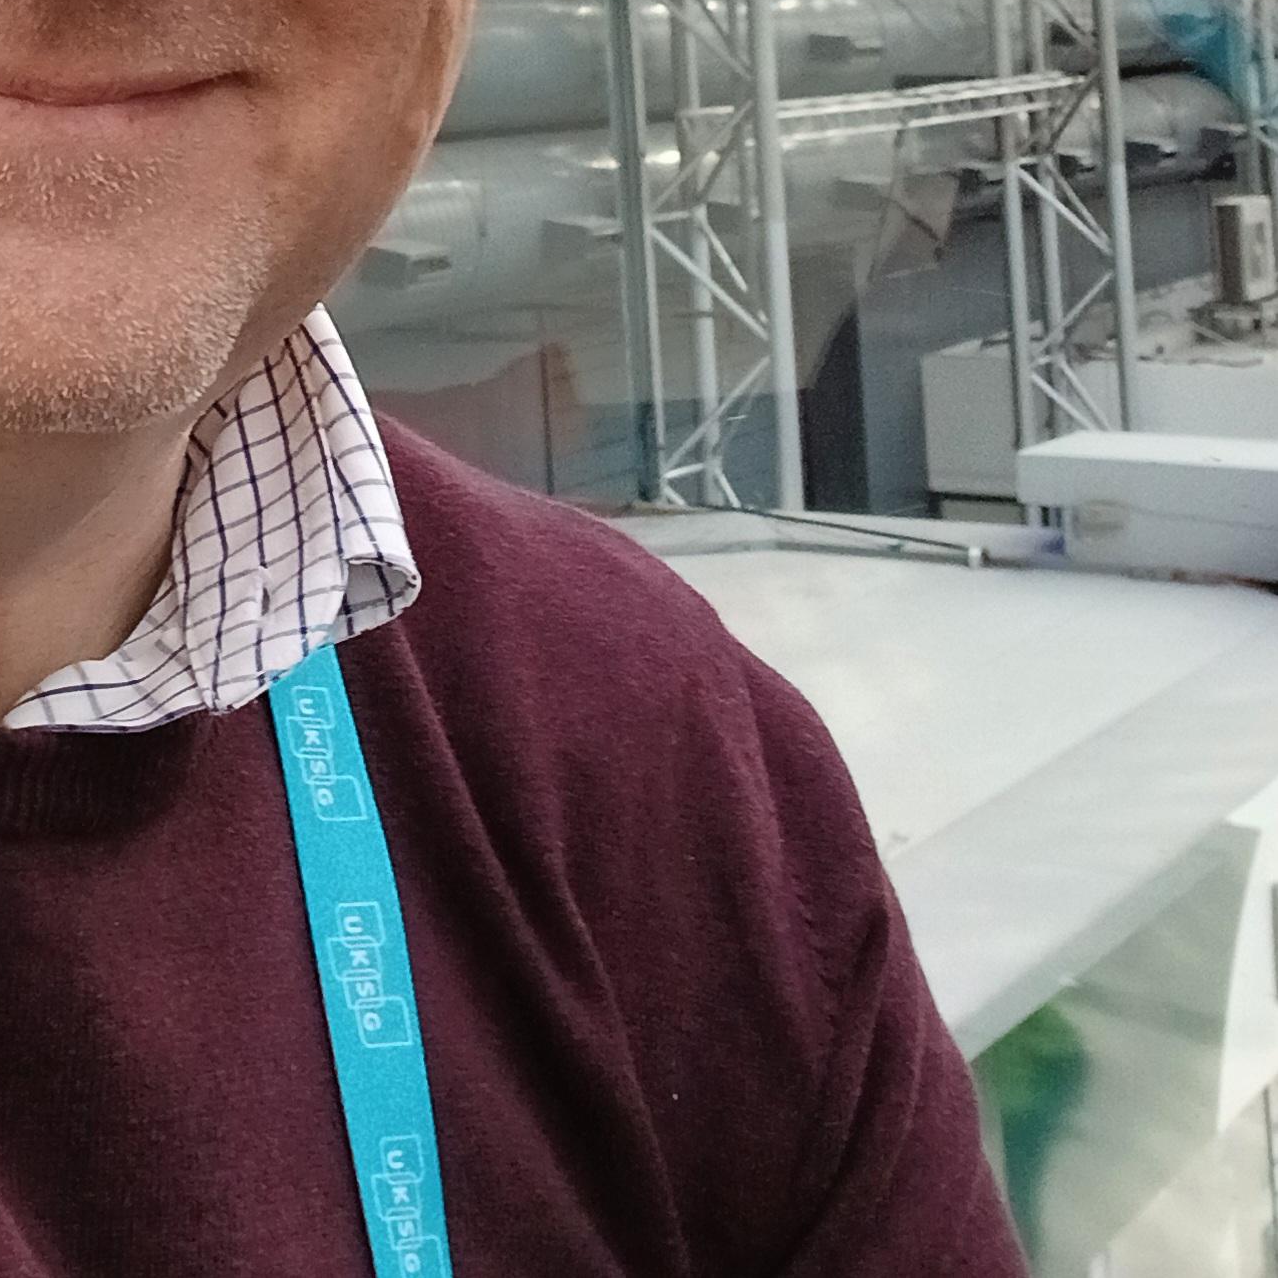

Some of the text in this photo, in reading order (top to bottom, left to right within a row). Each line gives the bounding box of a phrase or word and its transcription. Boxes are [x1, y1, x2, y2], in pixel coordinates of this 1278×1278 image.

[299, 698, 335, 807] UKSG
[343, 916, 382, 1031] UKSG
[387, 1150, 421, 1273] UKSG
